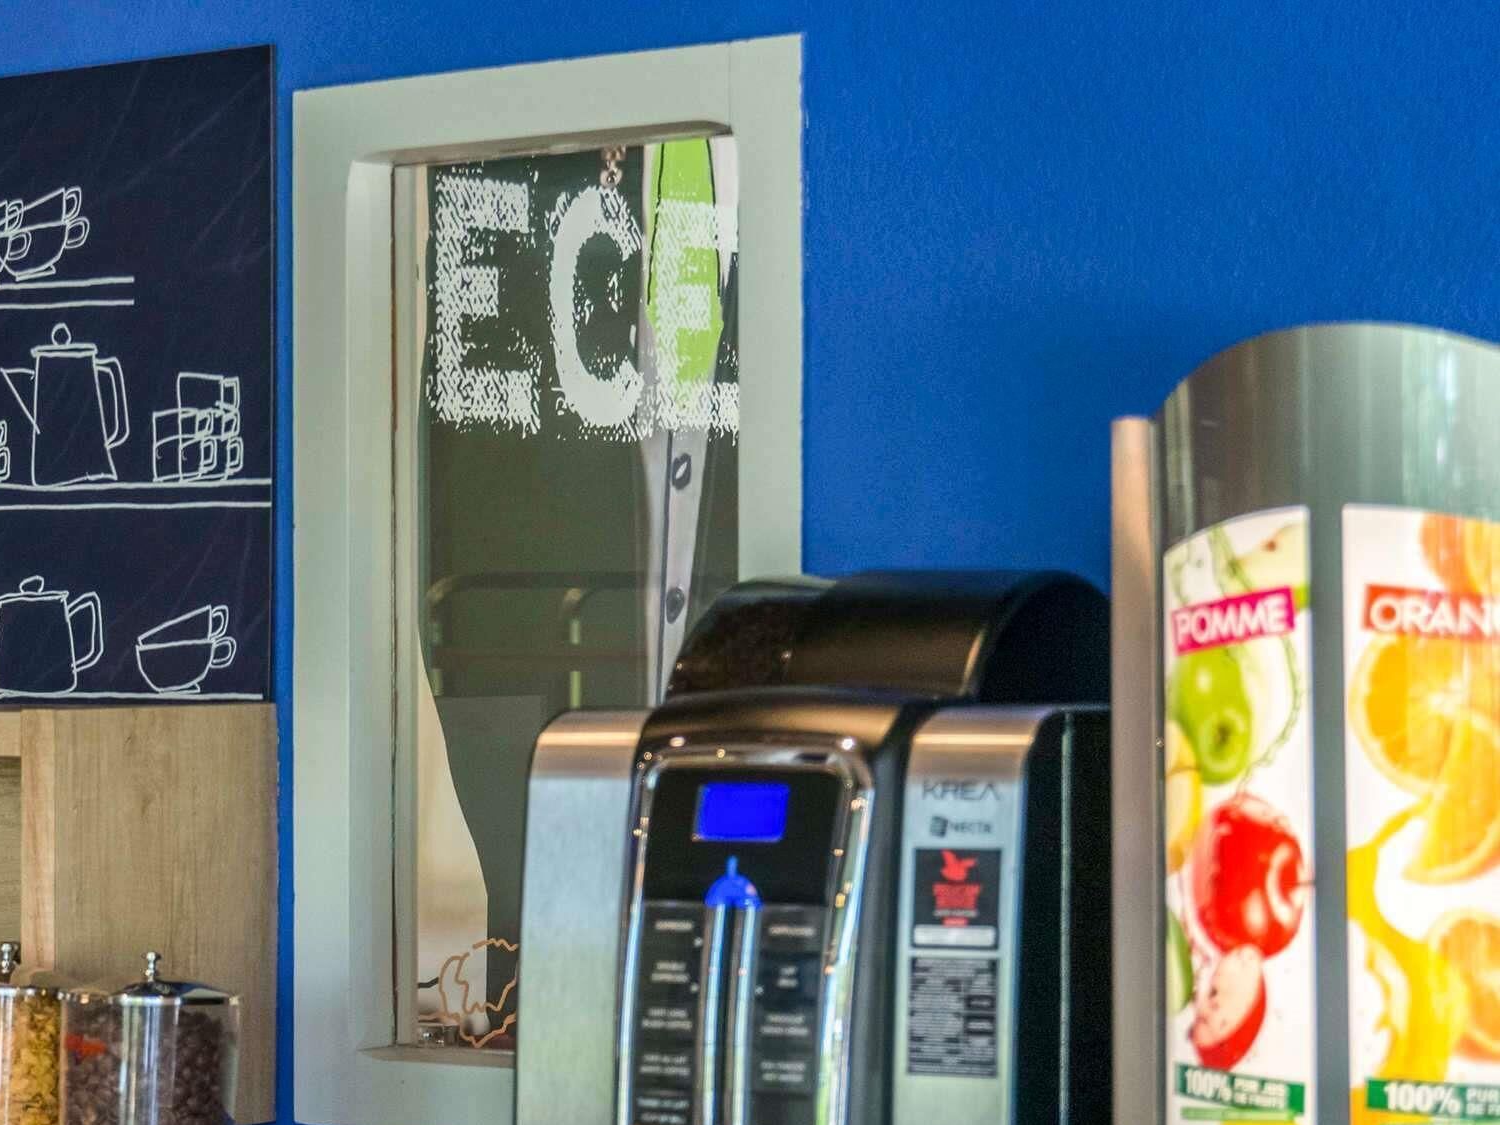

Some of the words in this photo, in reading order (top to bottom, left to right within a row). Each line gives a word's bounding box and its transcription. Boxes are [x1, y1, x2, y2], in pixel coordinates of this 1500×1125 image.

[1175, 594, 1288, 646] POMME
[1185, 1069, 1232, 1103] 100%
[1384, 1081, 1460, 1115] 100%
